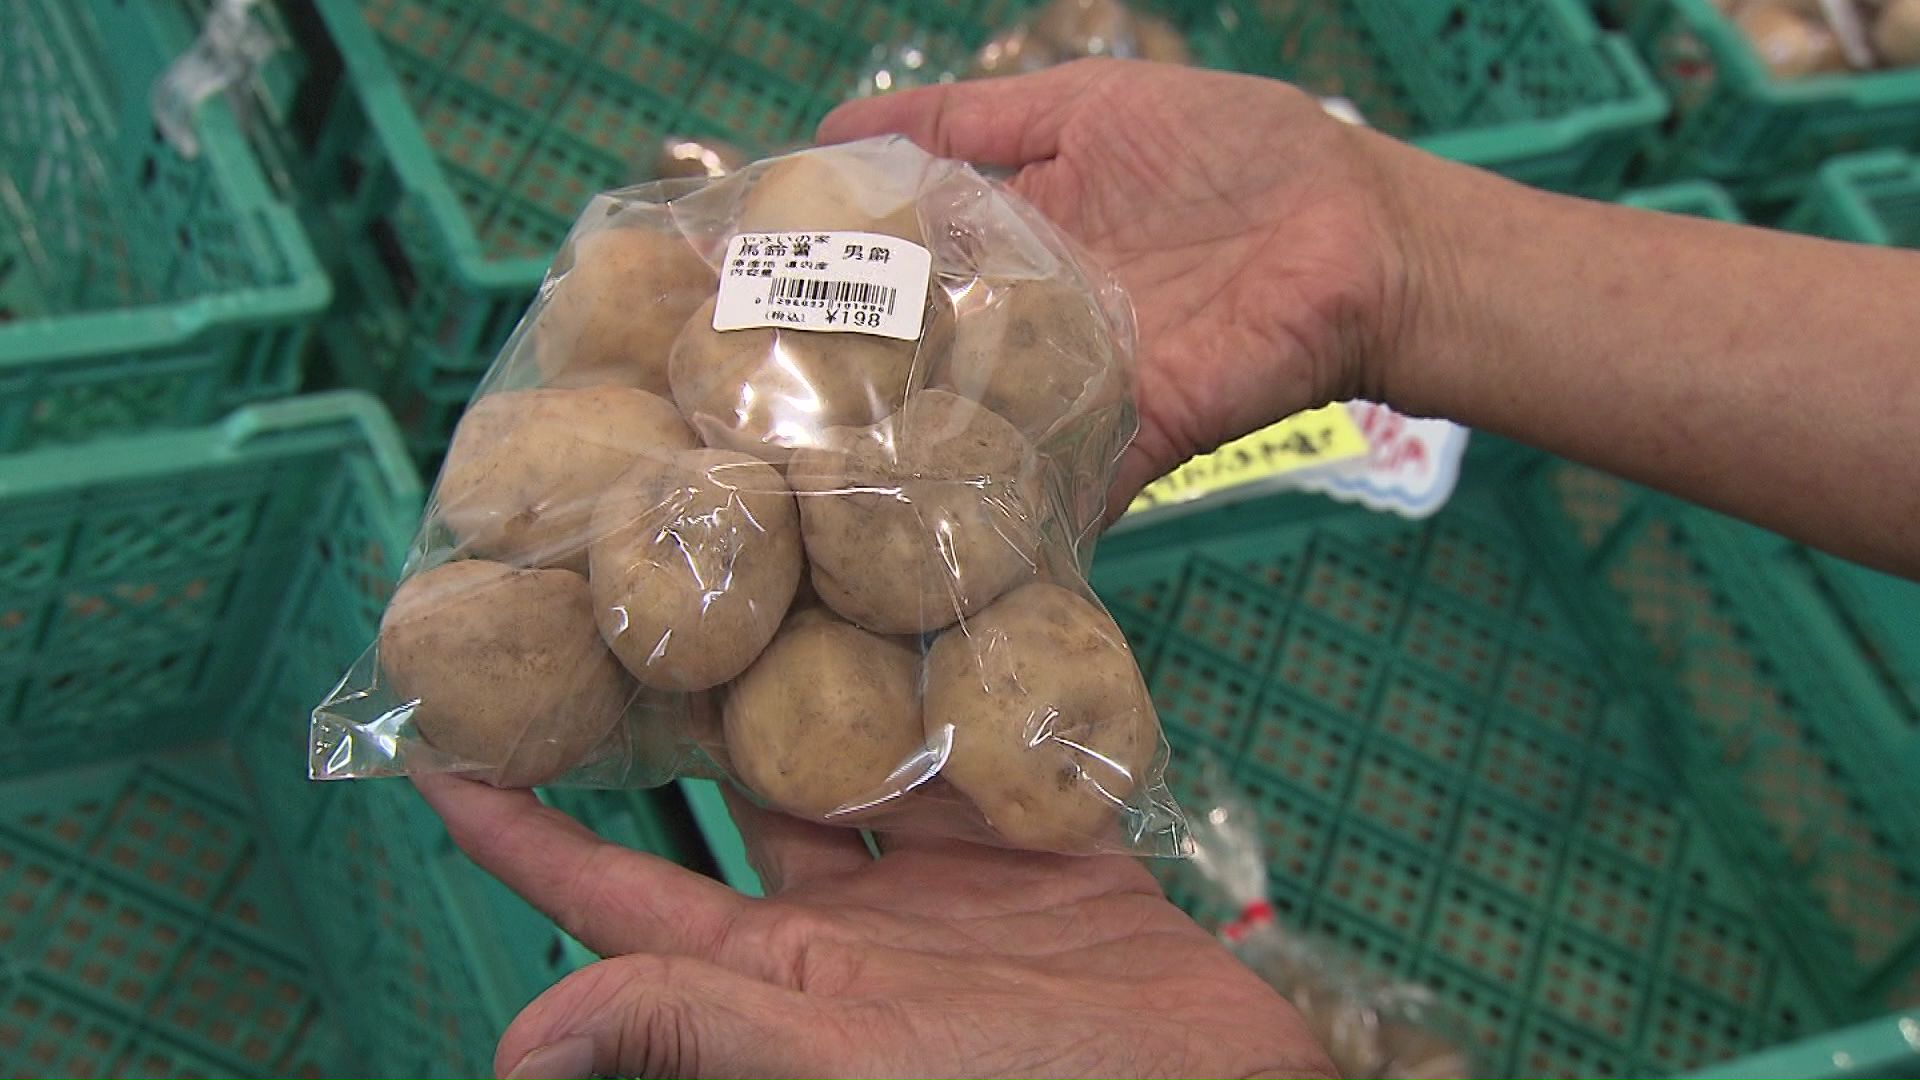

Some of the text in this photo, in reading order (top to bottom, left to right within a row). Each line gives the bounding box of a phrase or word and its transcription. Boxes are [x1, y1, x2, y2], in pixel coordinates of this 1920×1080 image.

[738, 243, 891, 263] 馬鈴薯 男爵
[825, 309, 881, 328] ¥198
